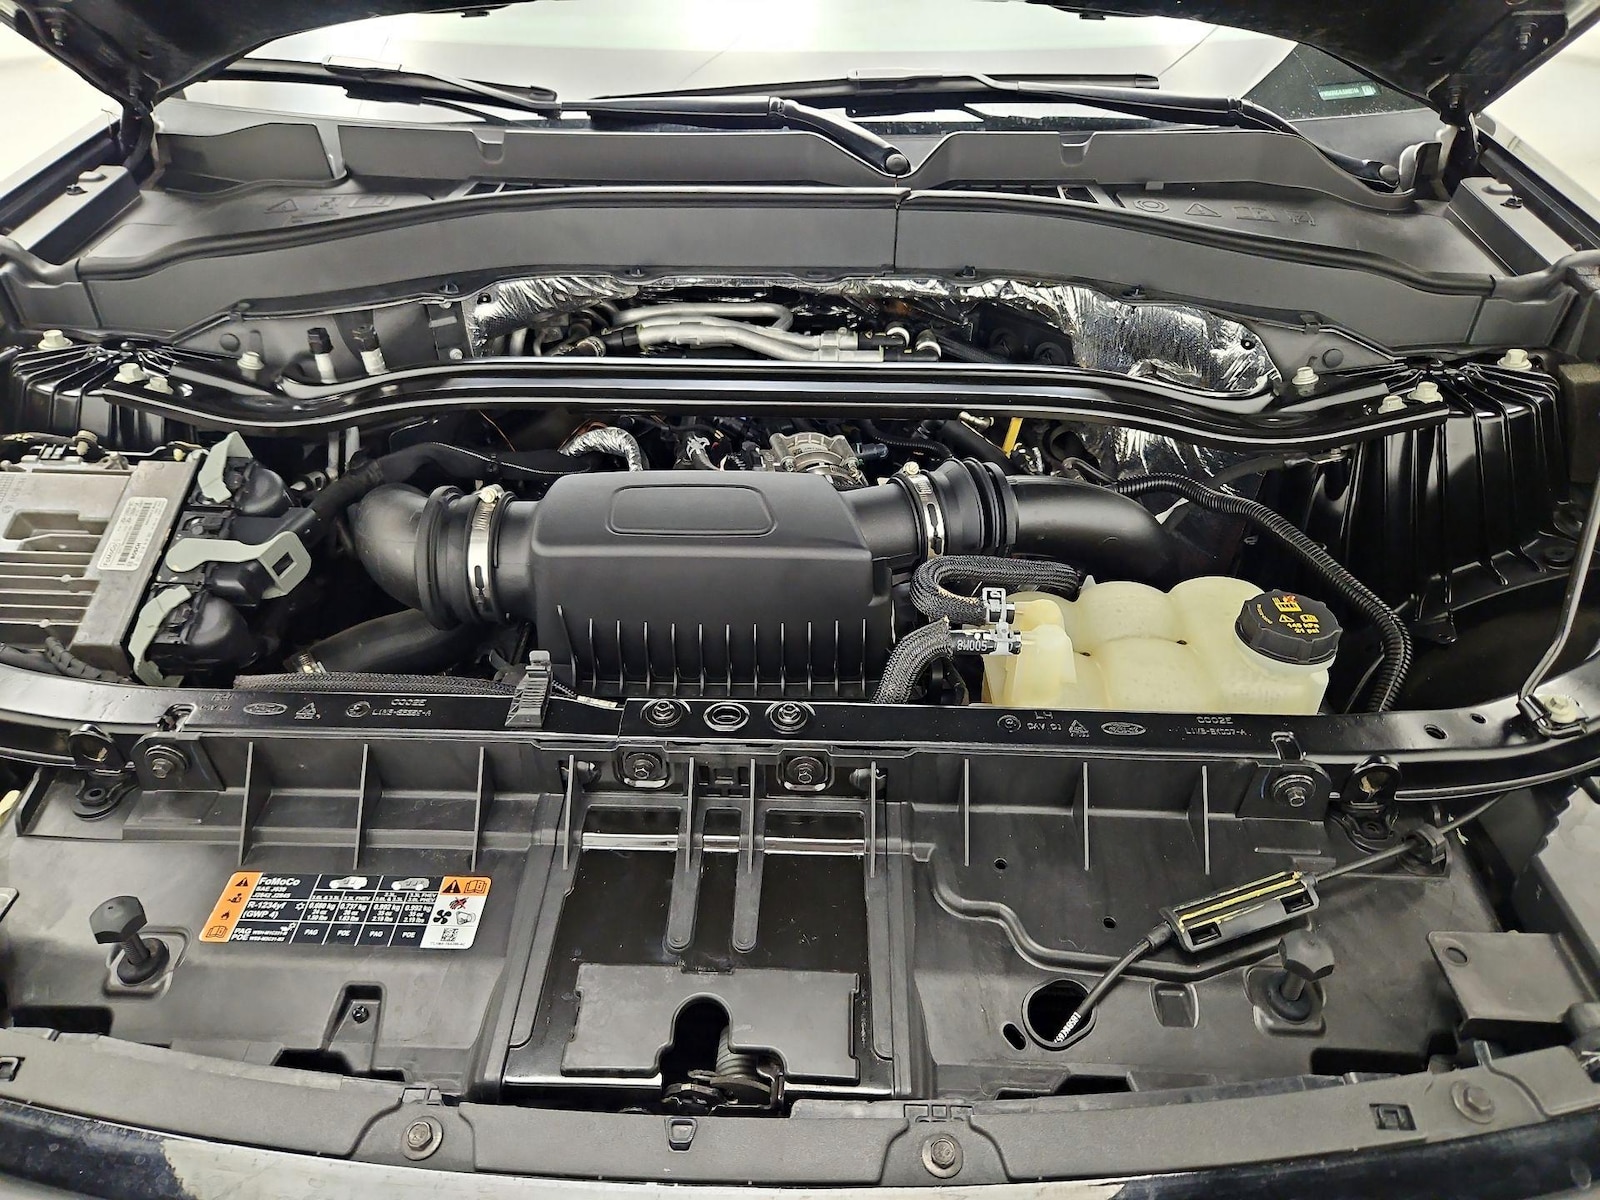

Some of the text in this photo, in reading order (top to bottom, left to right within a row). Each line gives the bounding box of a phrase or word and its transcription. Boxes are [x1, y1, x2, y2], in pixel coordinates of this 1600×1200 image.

[956, 639, 997, 652] 8W005-
[259, 876, 301, 886] FoMoCo
[247, 900, 288, 910] R-1234yf
[326, 902, 337, 911] kg
[357, 903, 368, 912] kg
[391, 904, 402, 912] kg
[422, 905, 433, 913] kg
[242, 910, 279, 920] (GWP 4)
[233, 927, 252, 935] PAG
